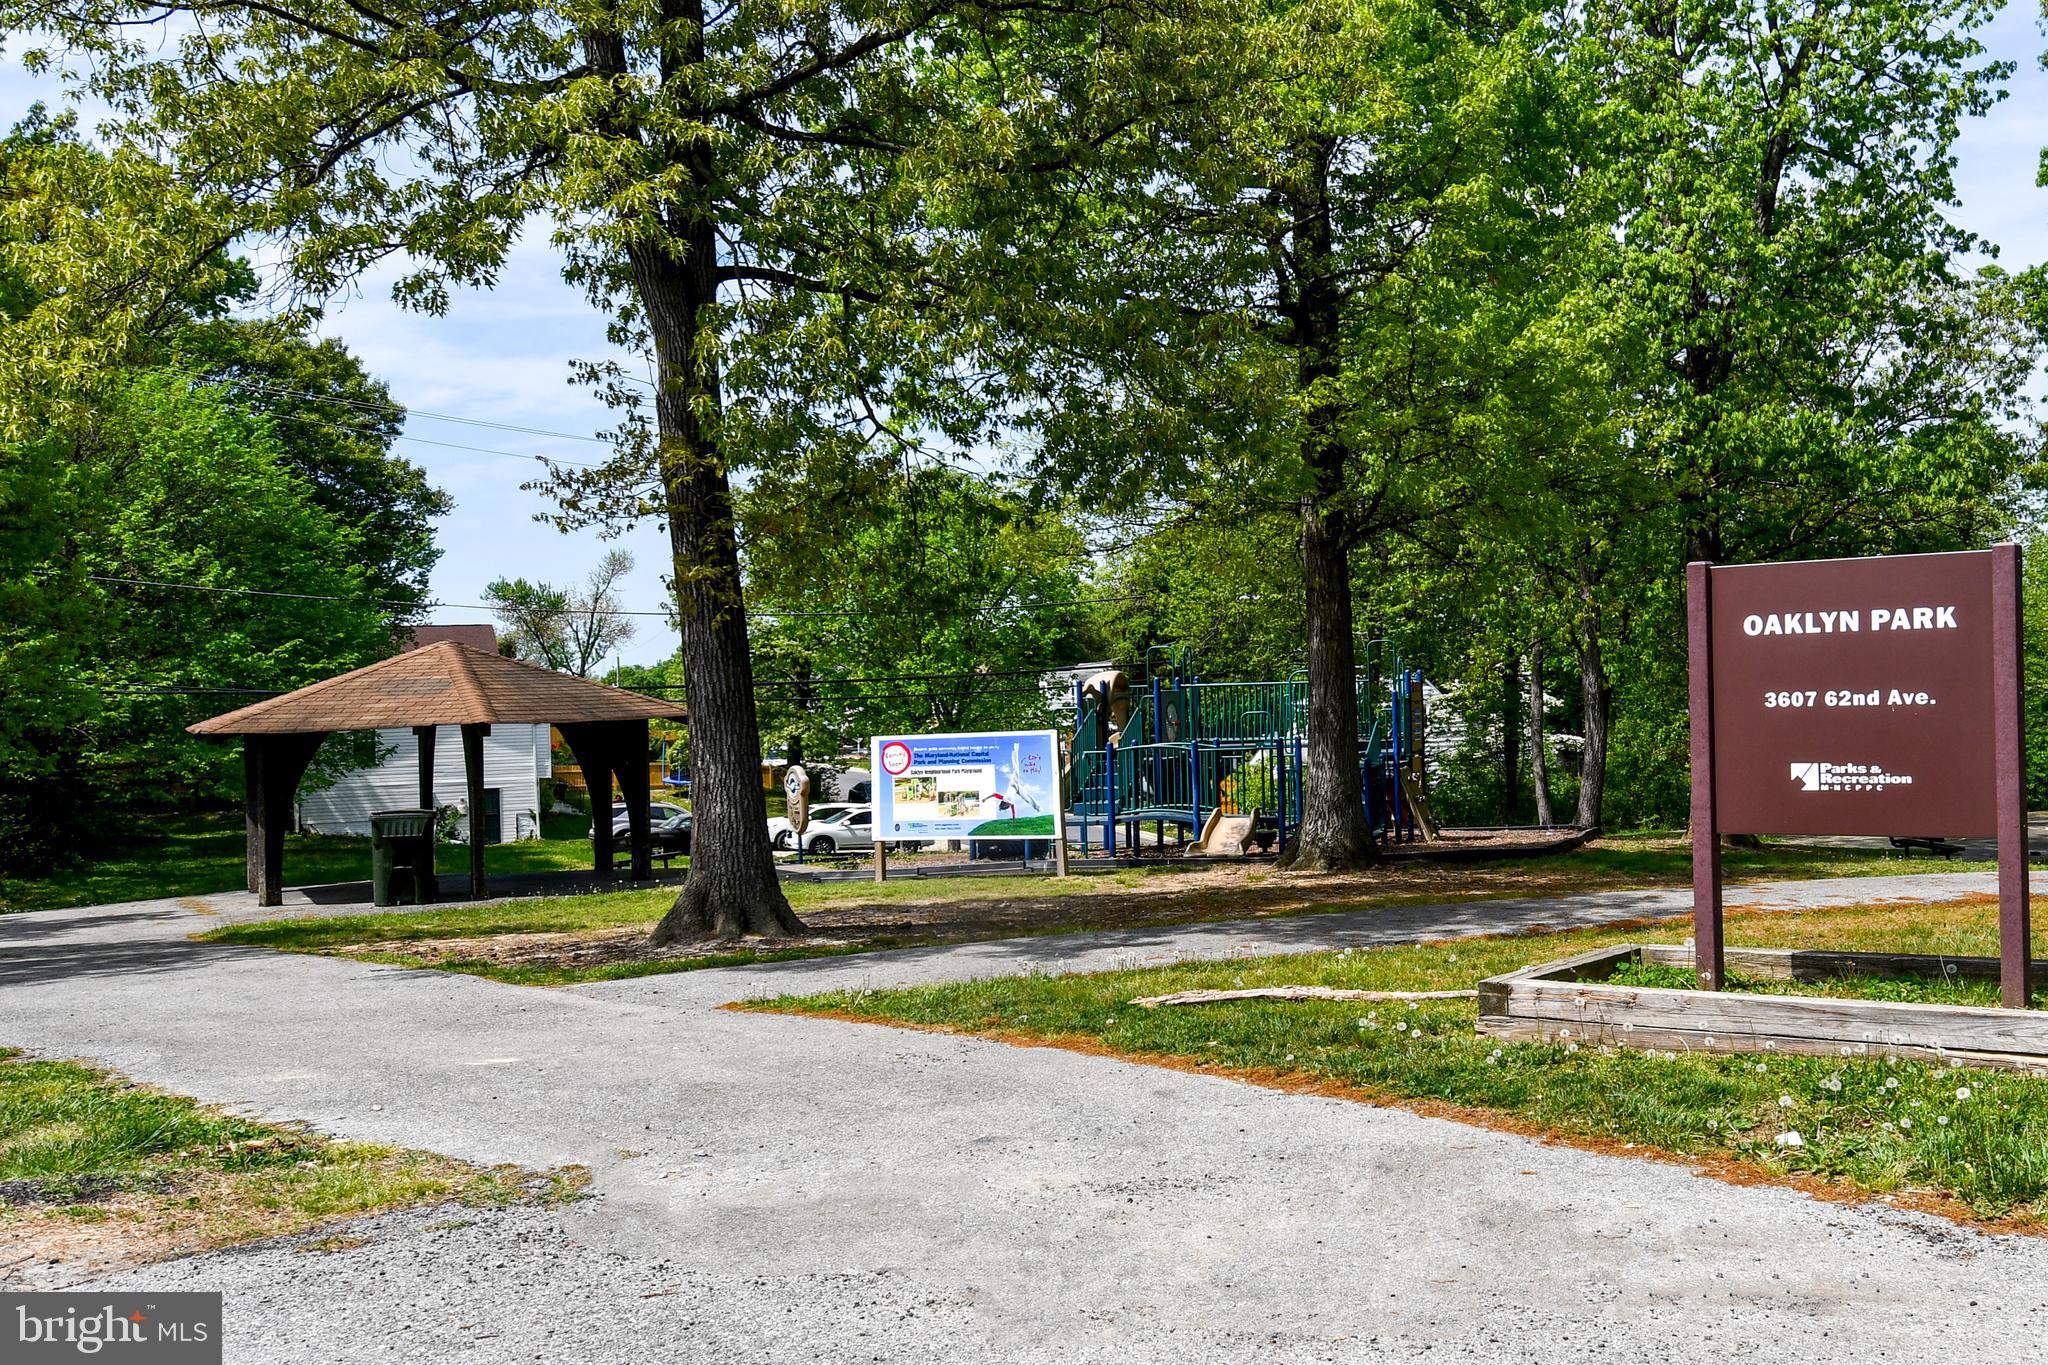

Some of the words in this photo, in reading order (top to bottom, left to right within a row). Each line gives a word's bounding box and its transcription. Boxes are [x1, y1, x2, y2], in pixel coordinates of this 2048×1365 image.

[1743, 610, 1860, 636] OAKLYN
[1871, 606, 1958, 631] PARK
[1765, 691, 1817, 708] 3607
[1824, 690, 1880, 707] 62nd
[1887, 689, 1936, 705] Ave.
[1820, 762, 1868, 774] Parks
[1869, 765, 1882, 774] &
[1820, 773, 1913, 784] Recreation
